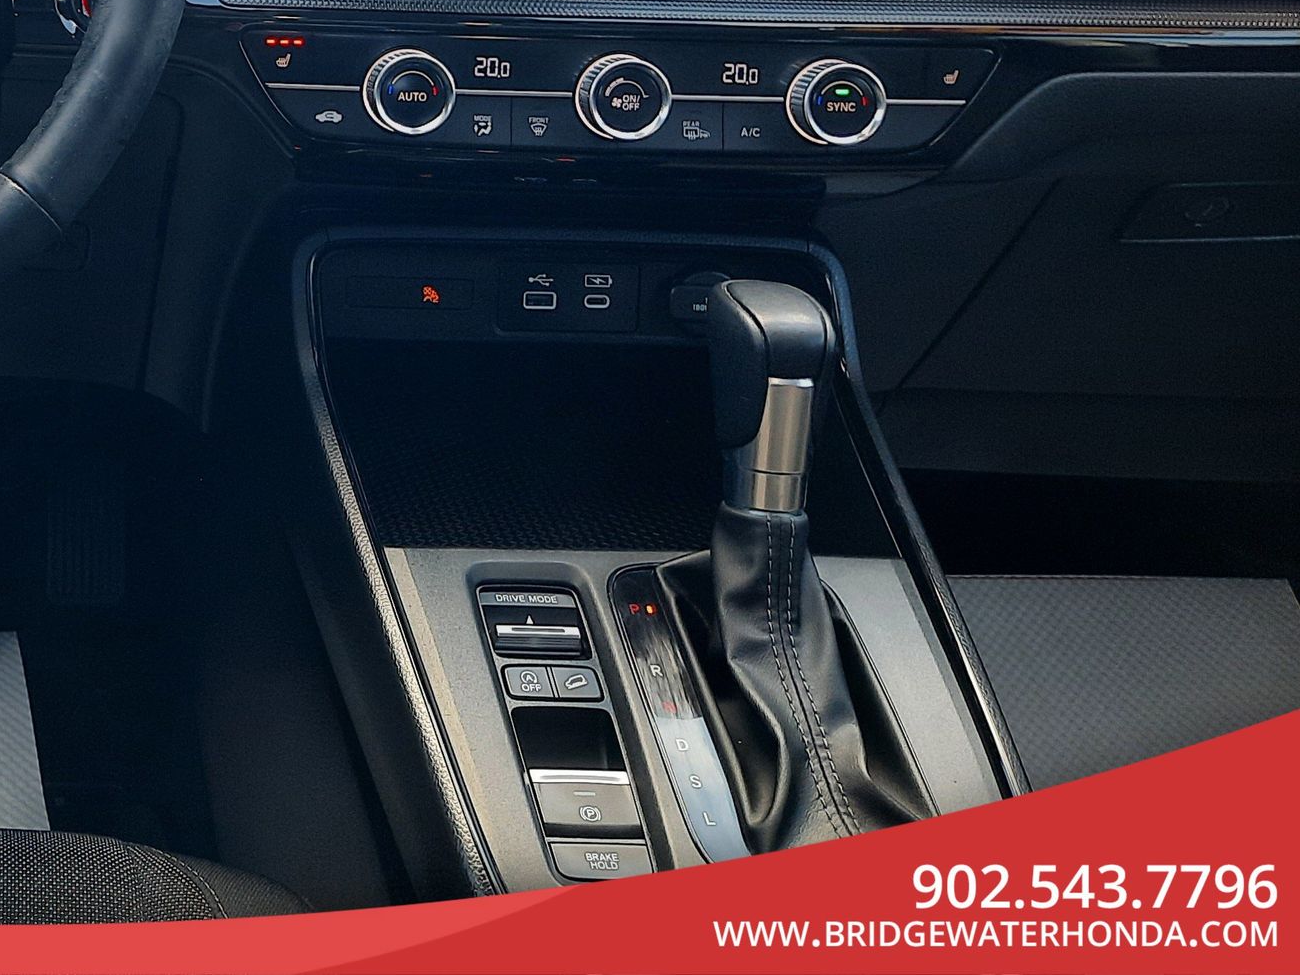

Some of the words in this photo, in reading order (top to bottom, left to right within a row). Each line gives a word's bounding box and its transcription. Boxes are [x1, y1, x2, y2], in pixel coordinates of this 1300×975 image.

[474, 57, 511, 78] 20.0
[722, 64, 759, 85] 20.0
[398, 91, 427, 102] AUTO
[622, 102, 641, 112] OFF
[826, 101, 857, 113] SYNC
[528, 116, 549, 124] FRONT
[741, 127, 761, 138] A/C
[495, 594, 526, 603] DRIVE
[529, 594, 558, 604] MODE
[629, 603, 640, 615] P
[650, 664, 663, 677] R
[521, 683, 542, 692] OFF
[675, 738, 689, 752] D
[690, 775, 702, 789] S
[703, 812, 716, 826] L
[585, 852, 620, 862] BRAKE
[589, 861, 619, 870] HOLD
